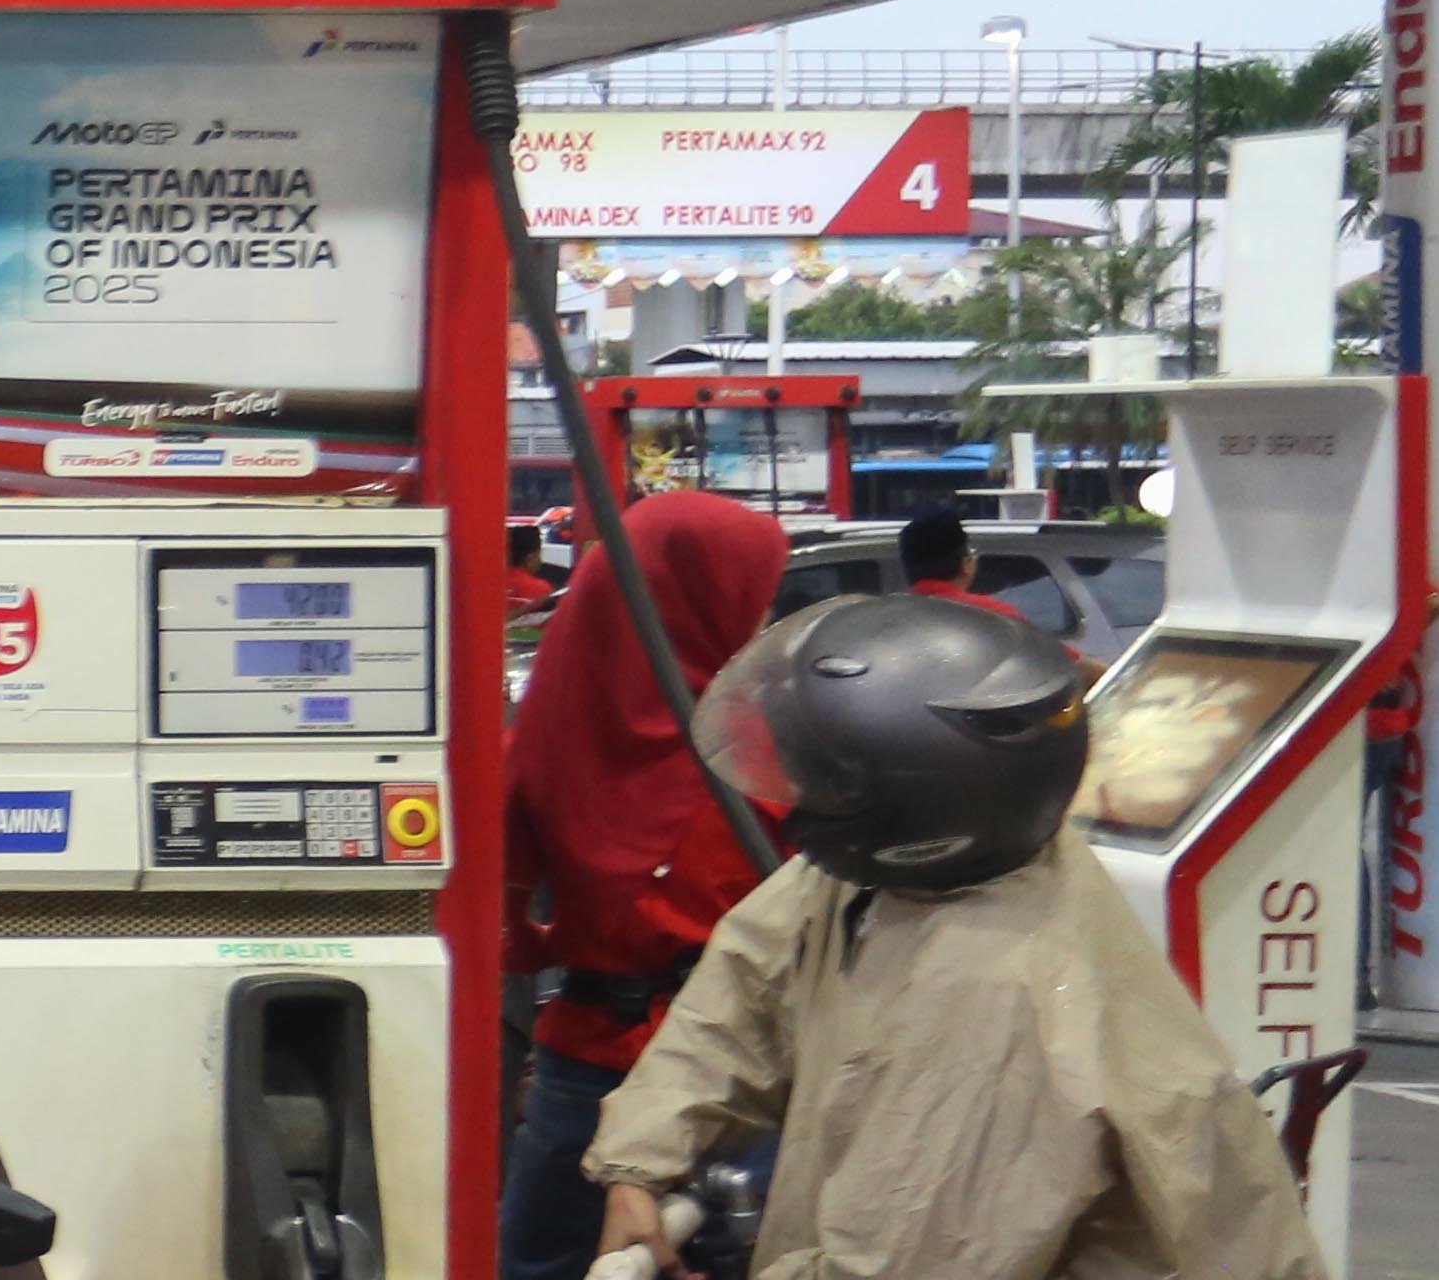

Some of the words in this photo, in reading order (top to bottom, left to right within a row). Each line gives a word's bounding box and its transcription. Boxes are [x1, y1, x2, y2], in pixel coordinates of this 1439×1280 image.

[661, 131, 794, 152] PERTAMAX
[800, 131, 826, 151] 92
[47, 168, 316, 200] PERTAMINA
[899, 163, 941, 211] 4
[46, 203, 195, 234] GRAND
[205, 203, 320, 234] PRIX
[663, 206, 780, 226] PERTALITE
[787, 205, 815, 225] 90
[45, 238, 103, 269] OF
[112, 238, 339, 269] INDONESIA
[42, 274, 162, 305] 2025
[1218, 435, 1256, 456] SELF
[1265, 434, 1334, 457] SERVICE
[217, 944, 354, 959] PERTALITE
[1258, 878, 1320, 1060] SELF
